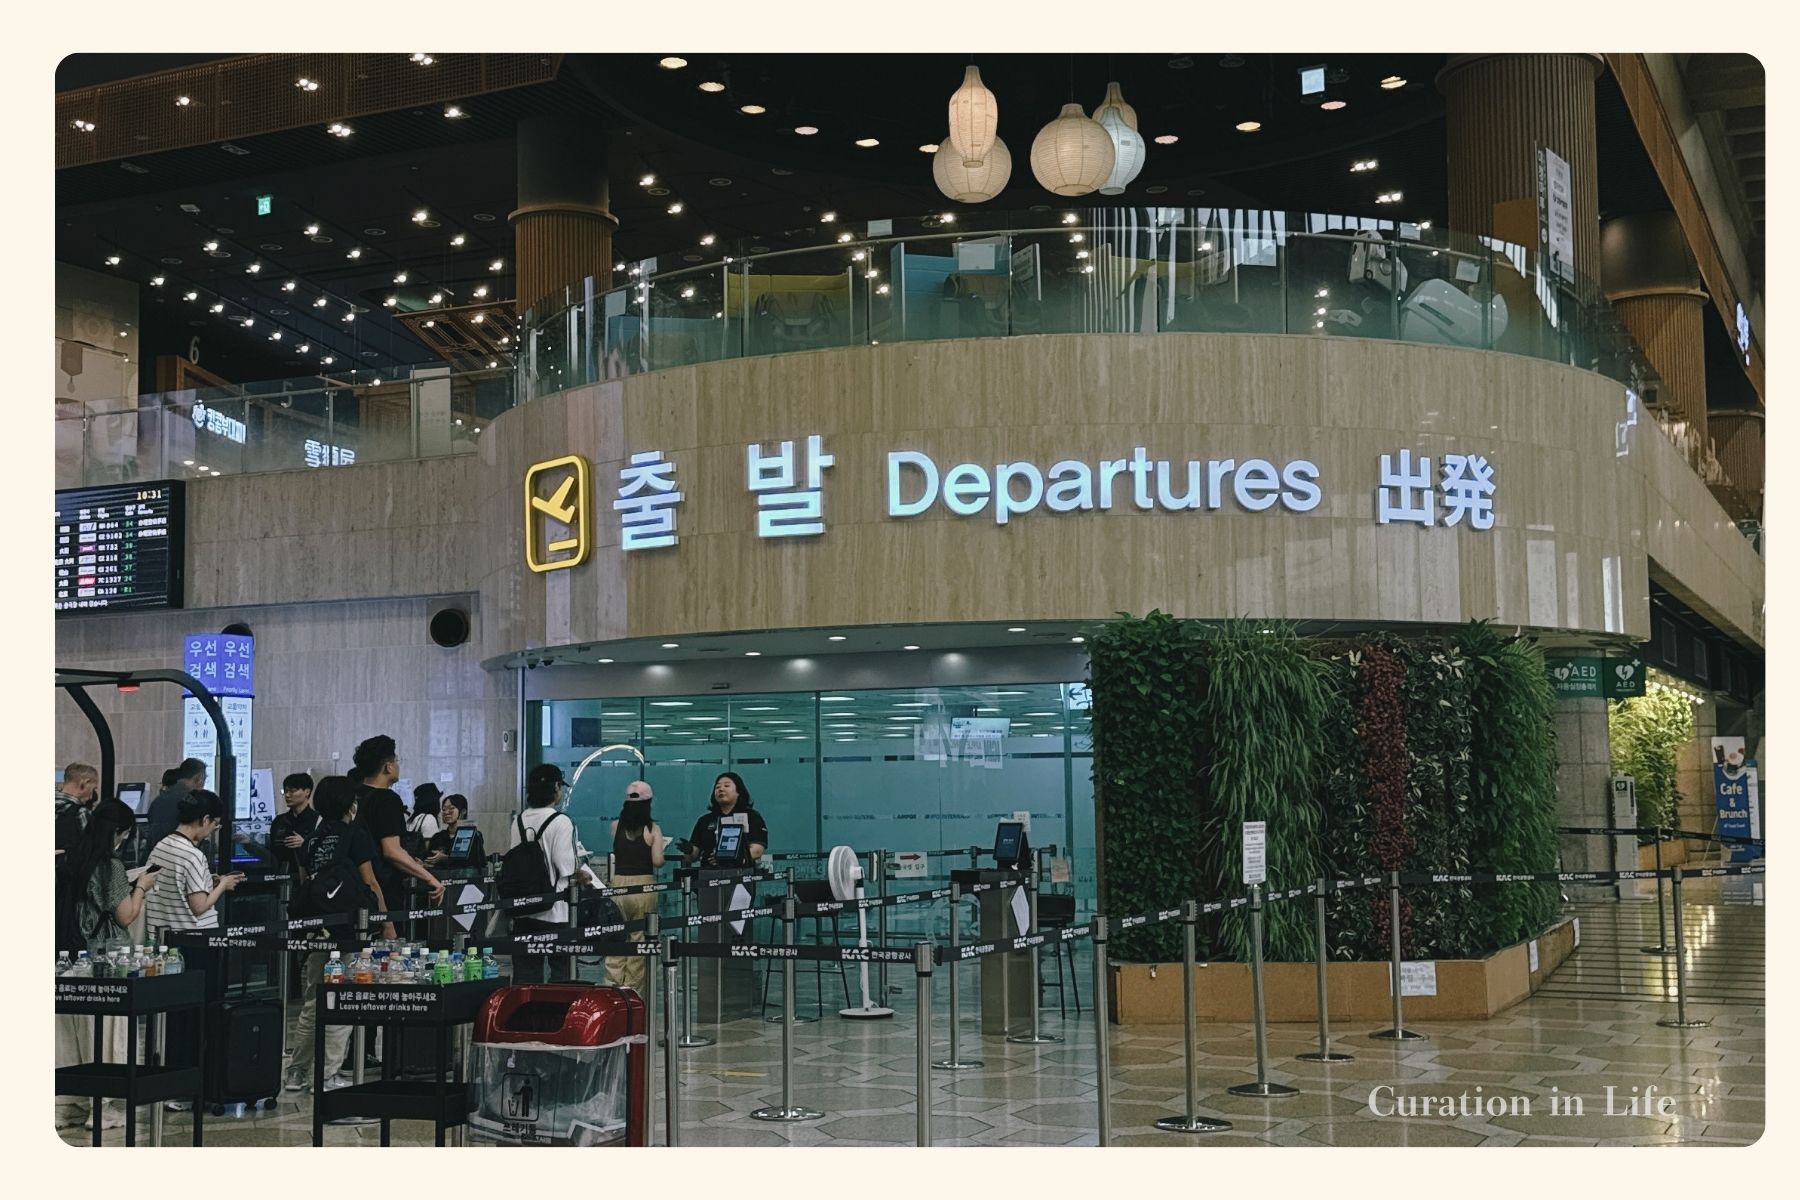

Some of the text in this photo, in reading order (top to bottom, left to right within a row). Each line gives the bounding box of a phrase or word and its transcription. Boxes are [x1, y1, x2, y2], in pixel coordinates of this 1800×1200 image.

[189, 336, 201, 365] 6
[137, 490, 161, 500] 10:31
[613, 435, 1496, 550] 출 발 Departures 出発
[190, 640, 217, 657] 우선
[224, 641, 250, 659] 우선
[190, 662, 217, 679] 검색
[224, 662, 250, 680] 검색
[1571, 666, 1597, 677] AED
[1720, 783, 1743, 795] Cafe
[1729, 798, 1736, 808] &
[1719, 809, 1748, 819] Brunch
[288, 919, 303, 930] KAC
[227, 926, 243, 938] KAC
[584, 925, 602, 938] KAC
[208, 937, 228, 948] KAC
[287, 939, 308, 951] KAC
[527, 943, 594, 955] KAC 한국공항공사
[731, 945, 798, 957] KAC 한국공항공사
[842, 948, 912, 960] KAC 한국공항공사
[63, 994, 86, 1002] leftover
[339, 991, 437, 1002] 남은 음료는 여기에 놓아주세요
[339, 1003, 359, 1011] Leave
[361, 1003, 387, 1011] leftover
[388, 1003, 411, 1011] drinks
